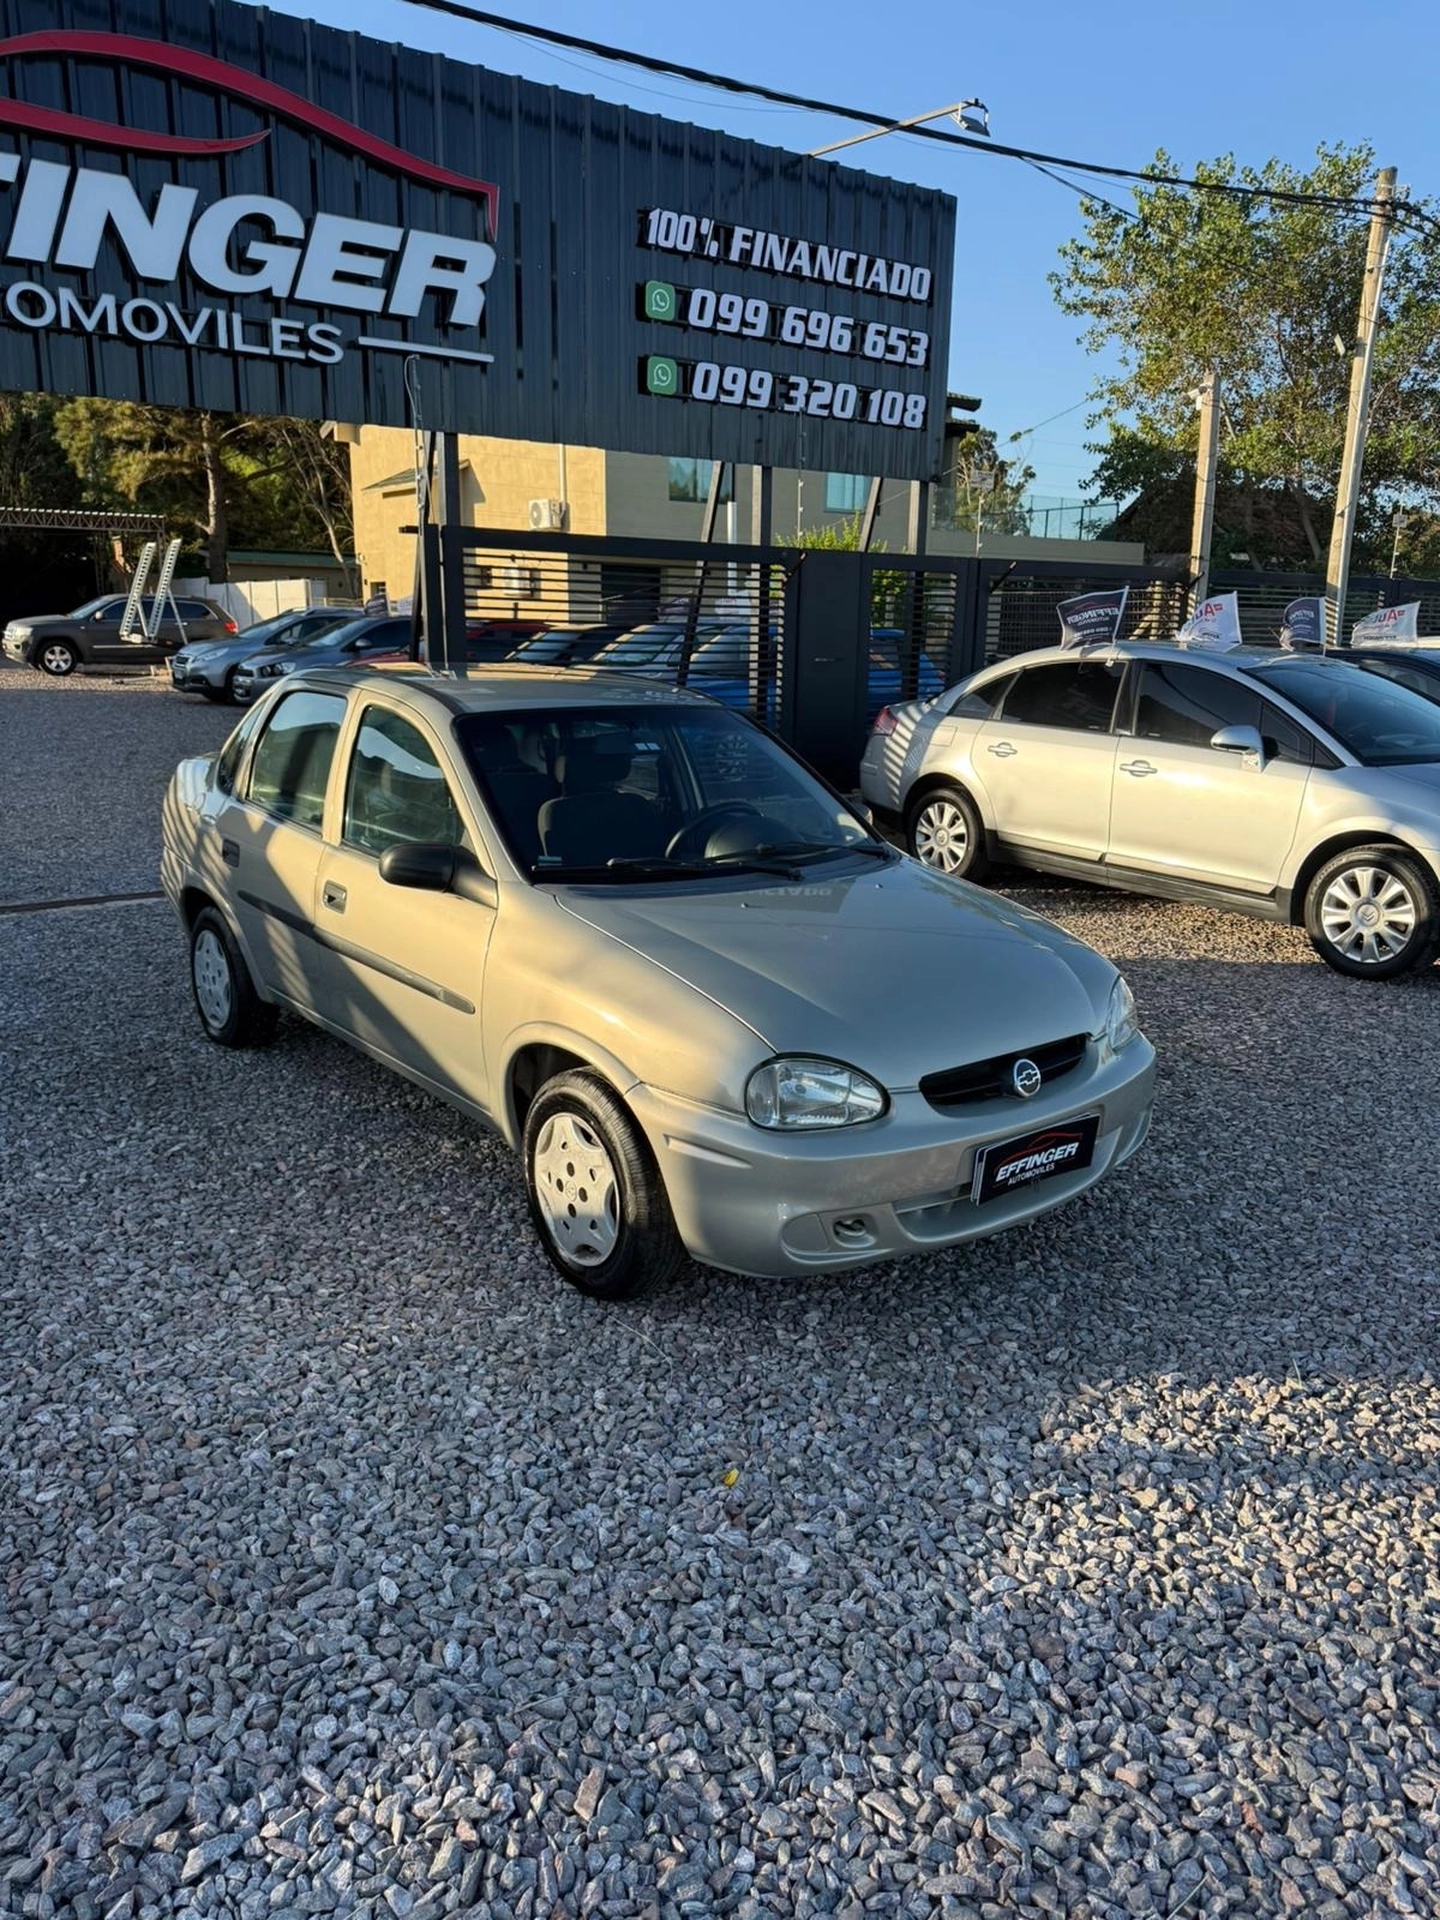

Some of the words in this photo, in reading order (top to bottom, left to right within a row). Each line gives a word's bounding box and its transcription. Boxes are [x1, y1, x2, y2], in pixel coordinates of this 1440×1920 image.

[0, 152, 497, 327] INGER
[648, 207, 719, 257] 100%
[729, 225, 931, 301] FINANCIADO
[6, 280, 345, 365] OMOVILES
[688, 288, 769, 338] 099
[781, 305, 854, 353] 696
[863, 322, 929, 366] 653
[692, 361, 773, 408] 099
[783, 375, 857, 420] 320
[867, 388, 927, 429] 108
[996, 1142, 1080, 1182] EFFINGER
[1007, 1162, 1056, 1186] AUTOMOVILES
